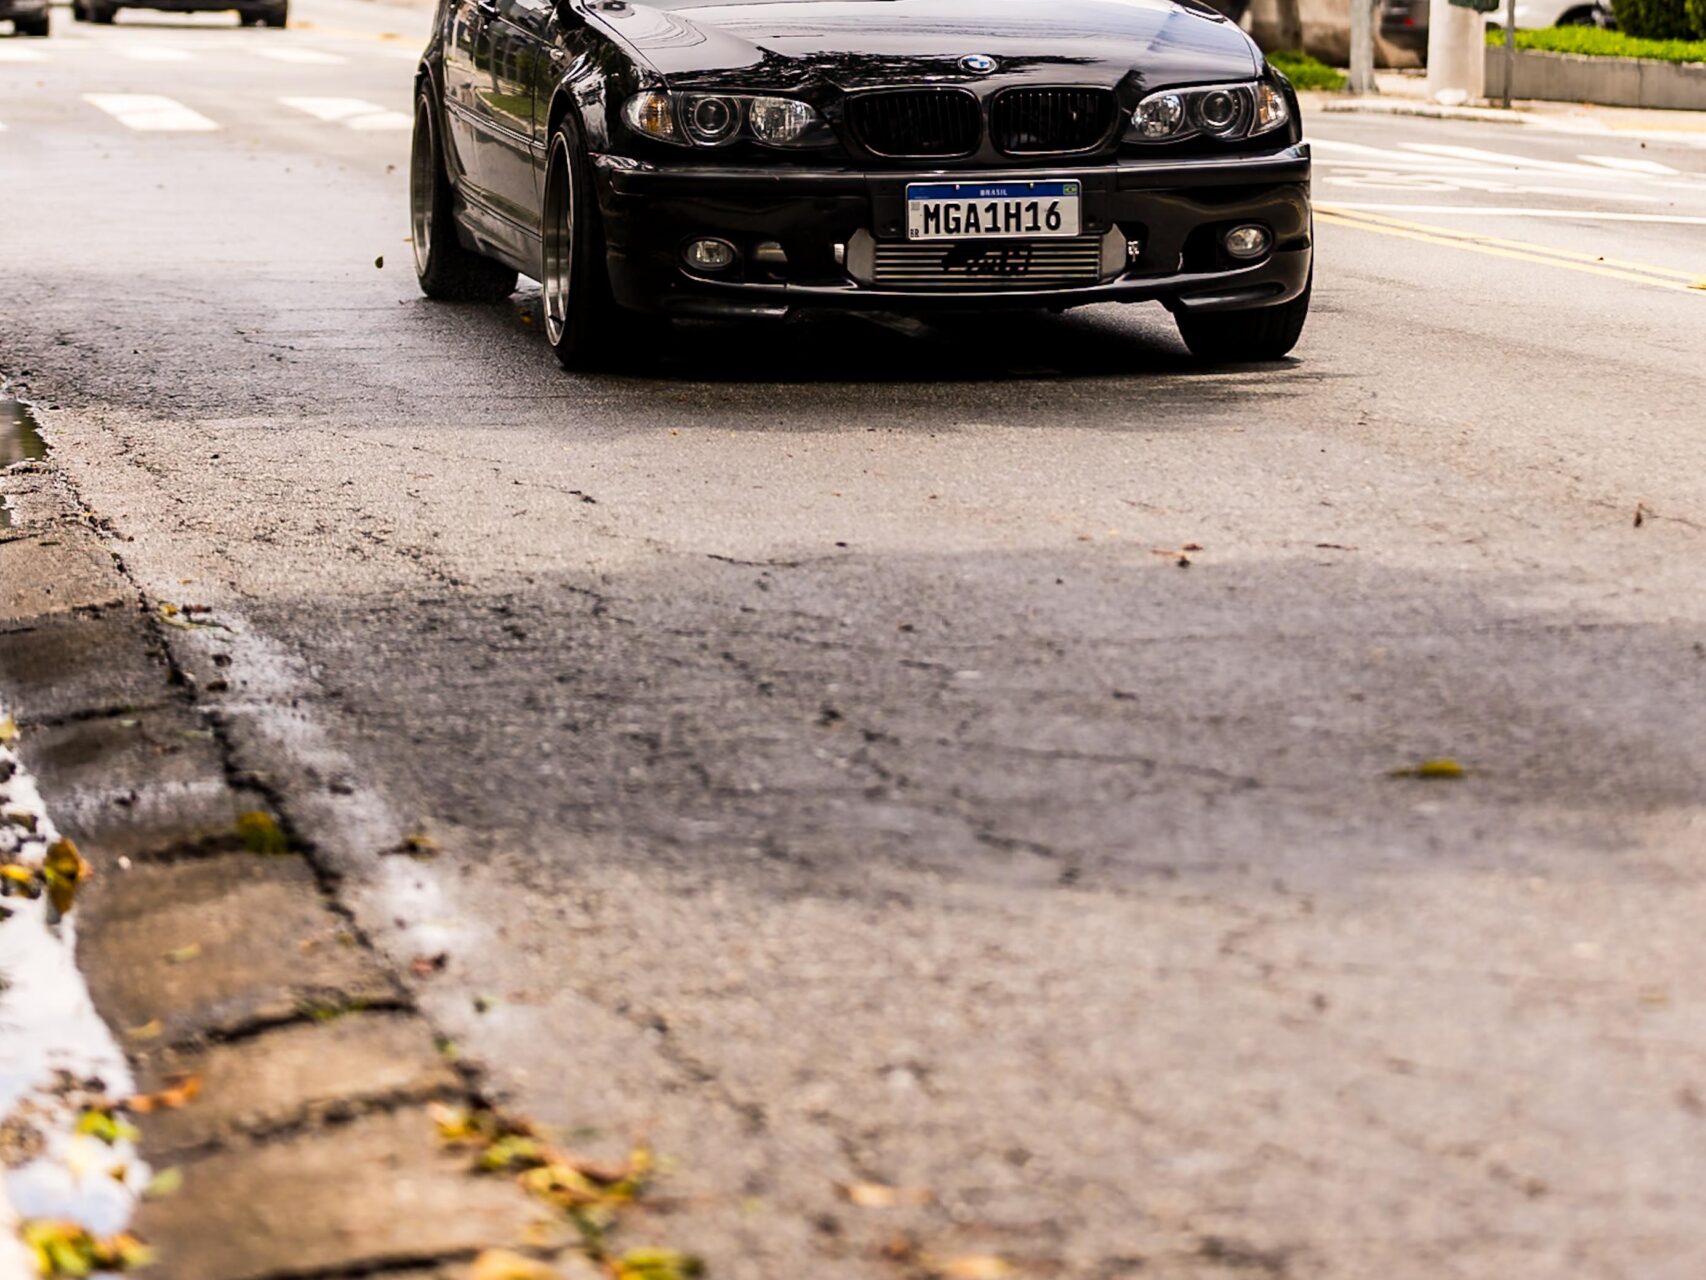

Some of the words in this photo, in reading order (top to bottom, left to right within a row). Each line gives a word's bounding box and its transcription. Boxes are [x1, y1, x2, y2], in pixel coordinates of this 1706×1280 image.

[979, 188, 1008, 197] BRASIL
[923, 200, 1061, 235] MGA1H16
[910, 228, 920, 238] BR
